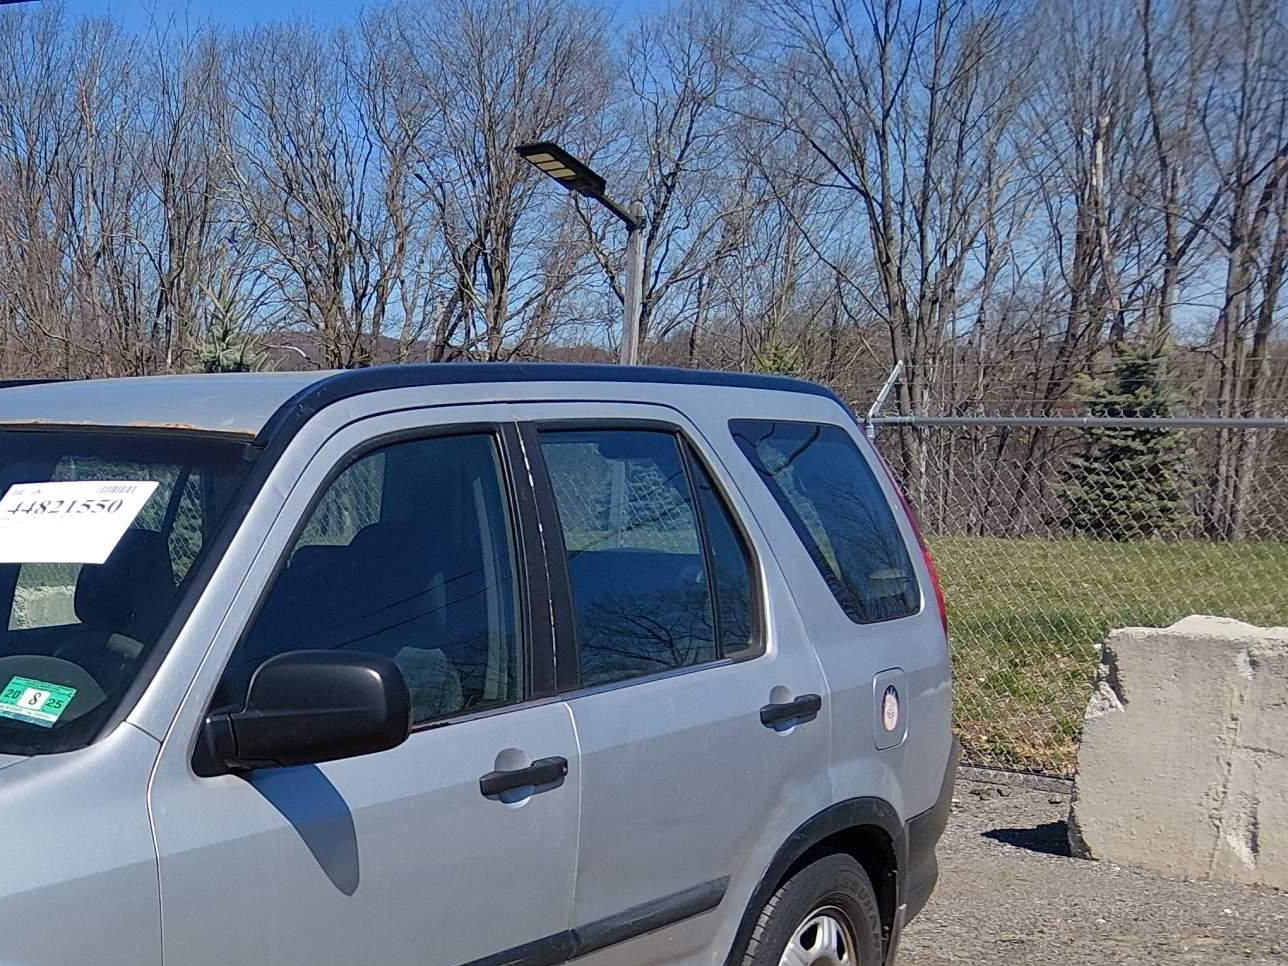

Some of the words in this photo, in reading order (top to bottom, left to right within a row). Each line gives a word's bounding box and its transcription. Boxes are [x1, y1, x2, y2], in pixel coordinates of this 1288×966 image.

[7, 499, 123, 514] 44821550
[4, 688, 21, 699] 20
[28, 692, 42, 705] 8
[46, 698, 64, 709] 25
